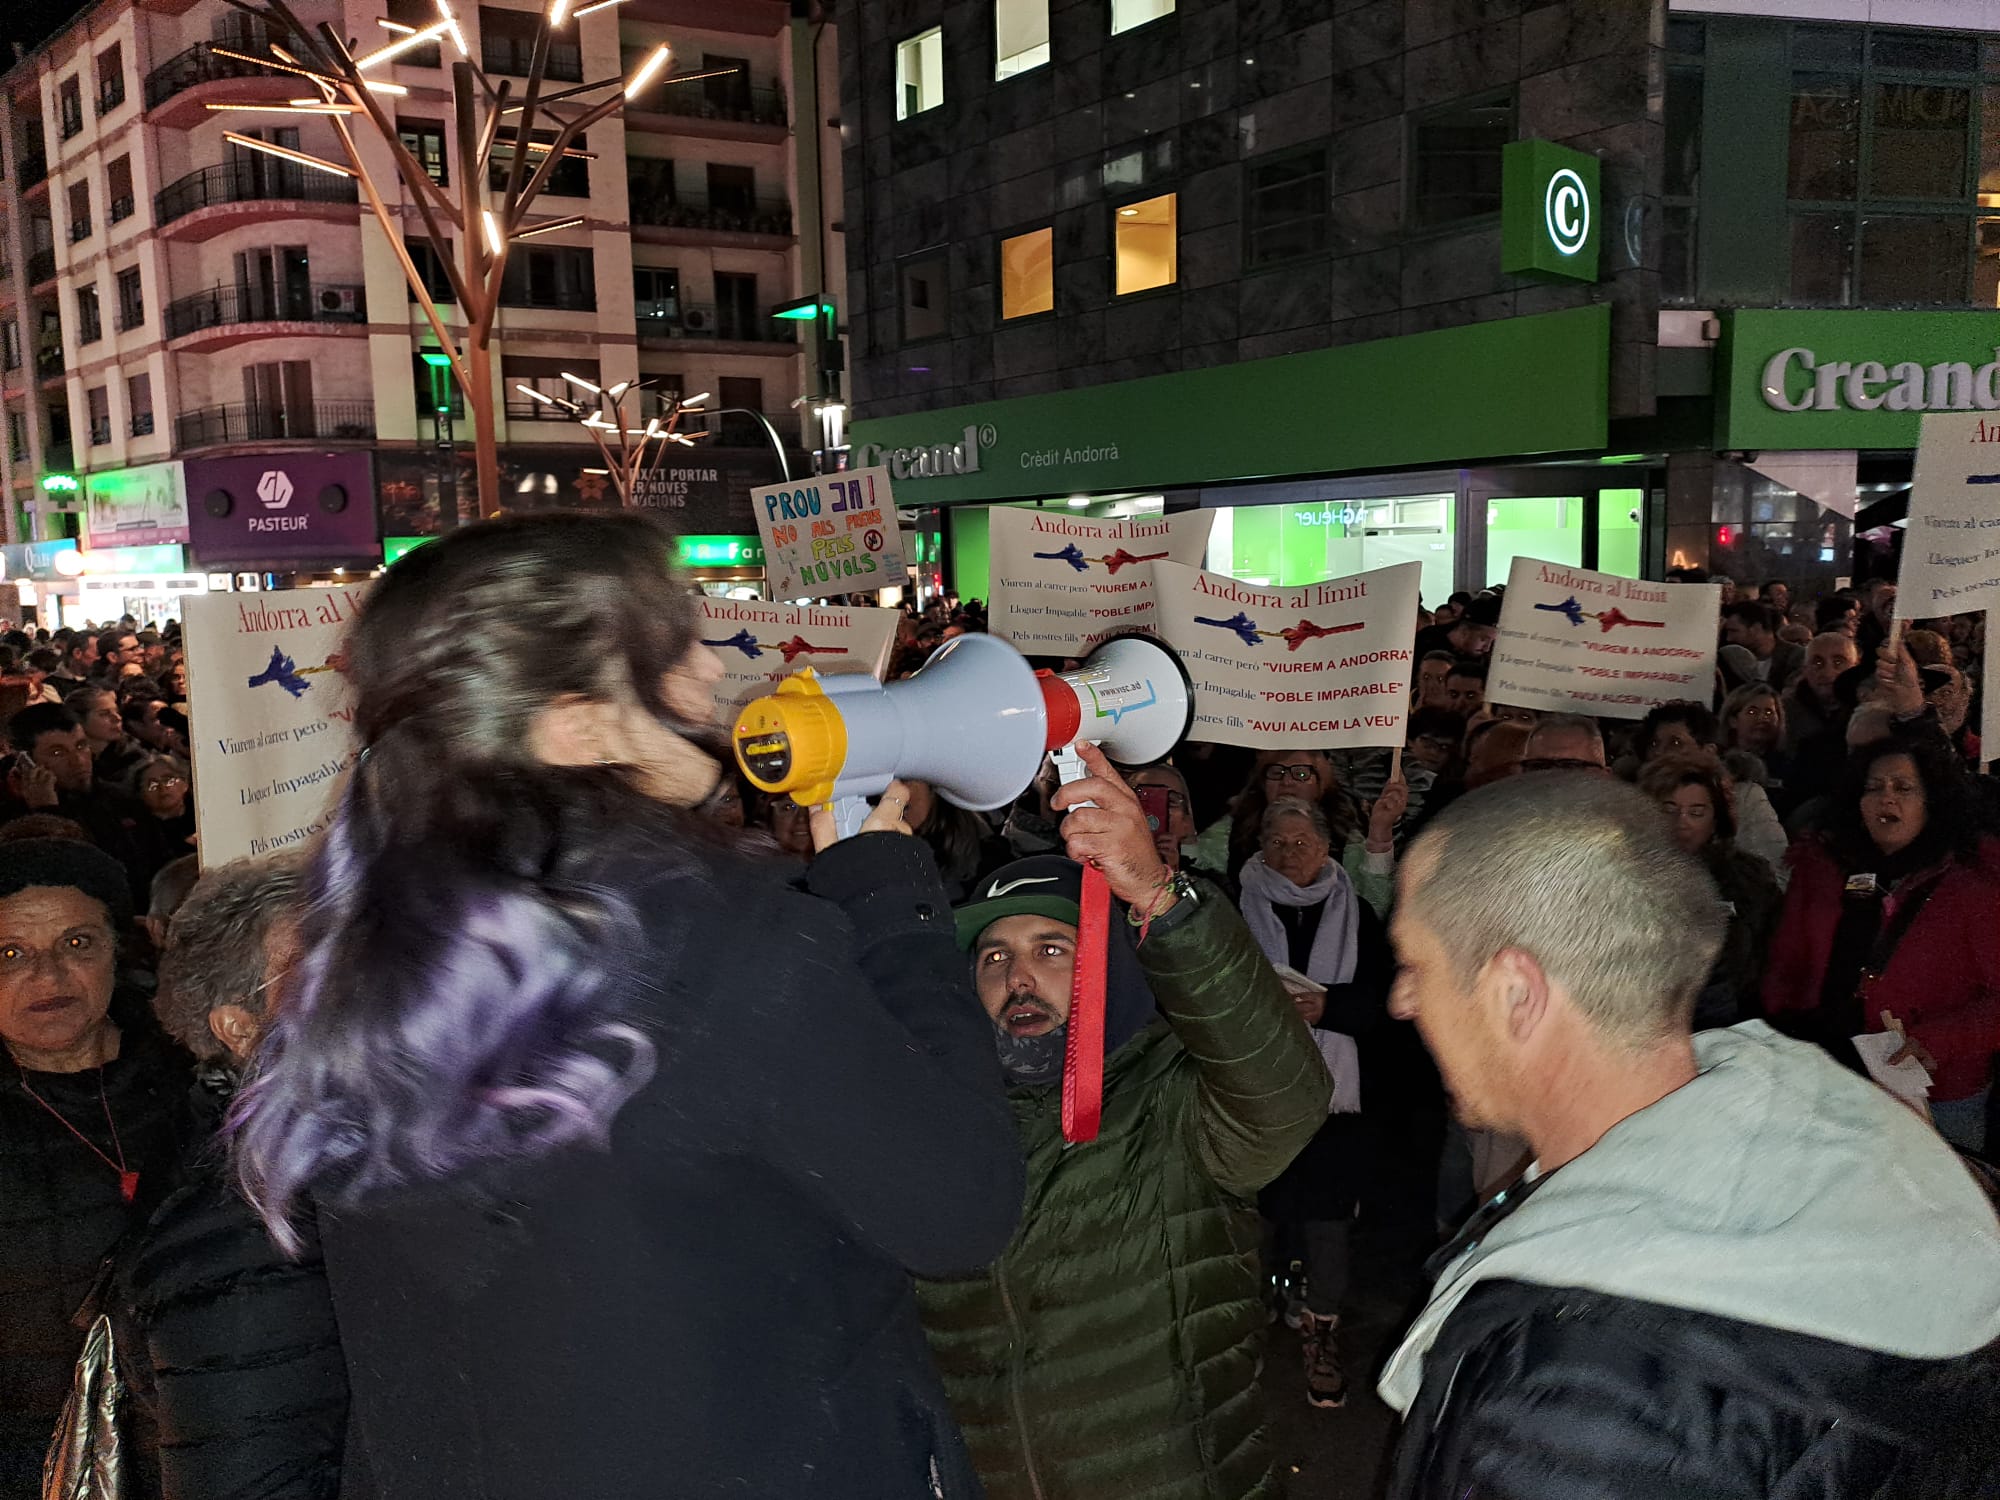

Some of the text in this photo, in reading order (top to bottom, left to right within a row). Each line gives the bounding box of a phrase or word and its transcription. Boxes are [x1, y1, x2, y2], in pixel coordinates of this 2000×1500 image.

[1762, 347, 2000, 412] Creand
[1020, 442, 1120, 469] Crèdit Andorrà
[670, 469, 718, 482] PORTAR
[765, 486, 821, 522] PROU
[248, 515, 308, 532] PASTEUR
[771, 524, 798, 548] NO
[811, 519, 836, 538] ALS
[1030, 515, 1172, 539] Andorra al límit
[810, 533, 856, 561] PELS
[1140, 580, 1147, 589] A
[1192, 574, 1369, 609] Andorra al límit
[1536, 565, 1602, 594] Andorra
[1607, 580, 1621, 598] al
[238, 599, 312, 633] Andorra
[315, 593, 344, 624] al
[696, 601, 852, 628] Andorra al límit
[1193, 649, 1202, 658] al
[1204, 653, 1233, 666] carrer
[1263, 658, 1323, 673] "VIUREM
[1326, 658, 1337, 671] A
[1339, 649, 1413, 669] ANDORRA"
[1204, 681, 1404, 702] Impagable "POBLE IMPARABLE"
[1226, 715, 1244, 728] fills
[1247, 719, 1287, 732] "AVUI
[1289, 719, 1340, 732] ALCEM
[1343, 717, 1361, 730] LA
[1364, 715, 1400, 728] VEU"
[272, 759, 349, 795] Impagable
